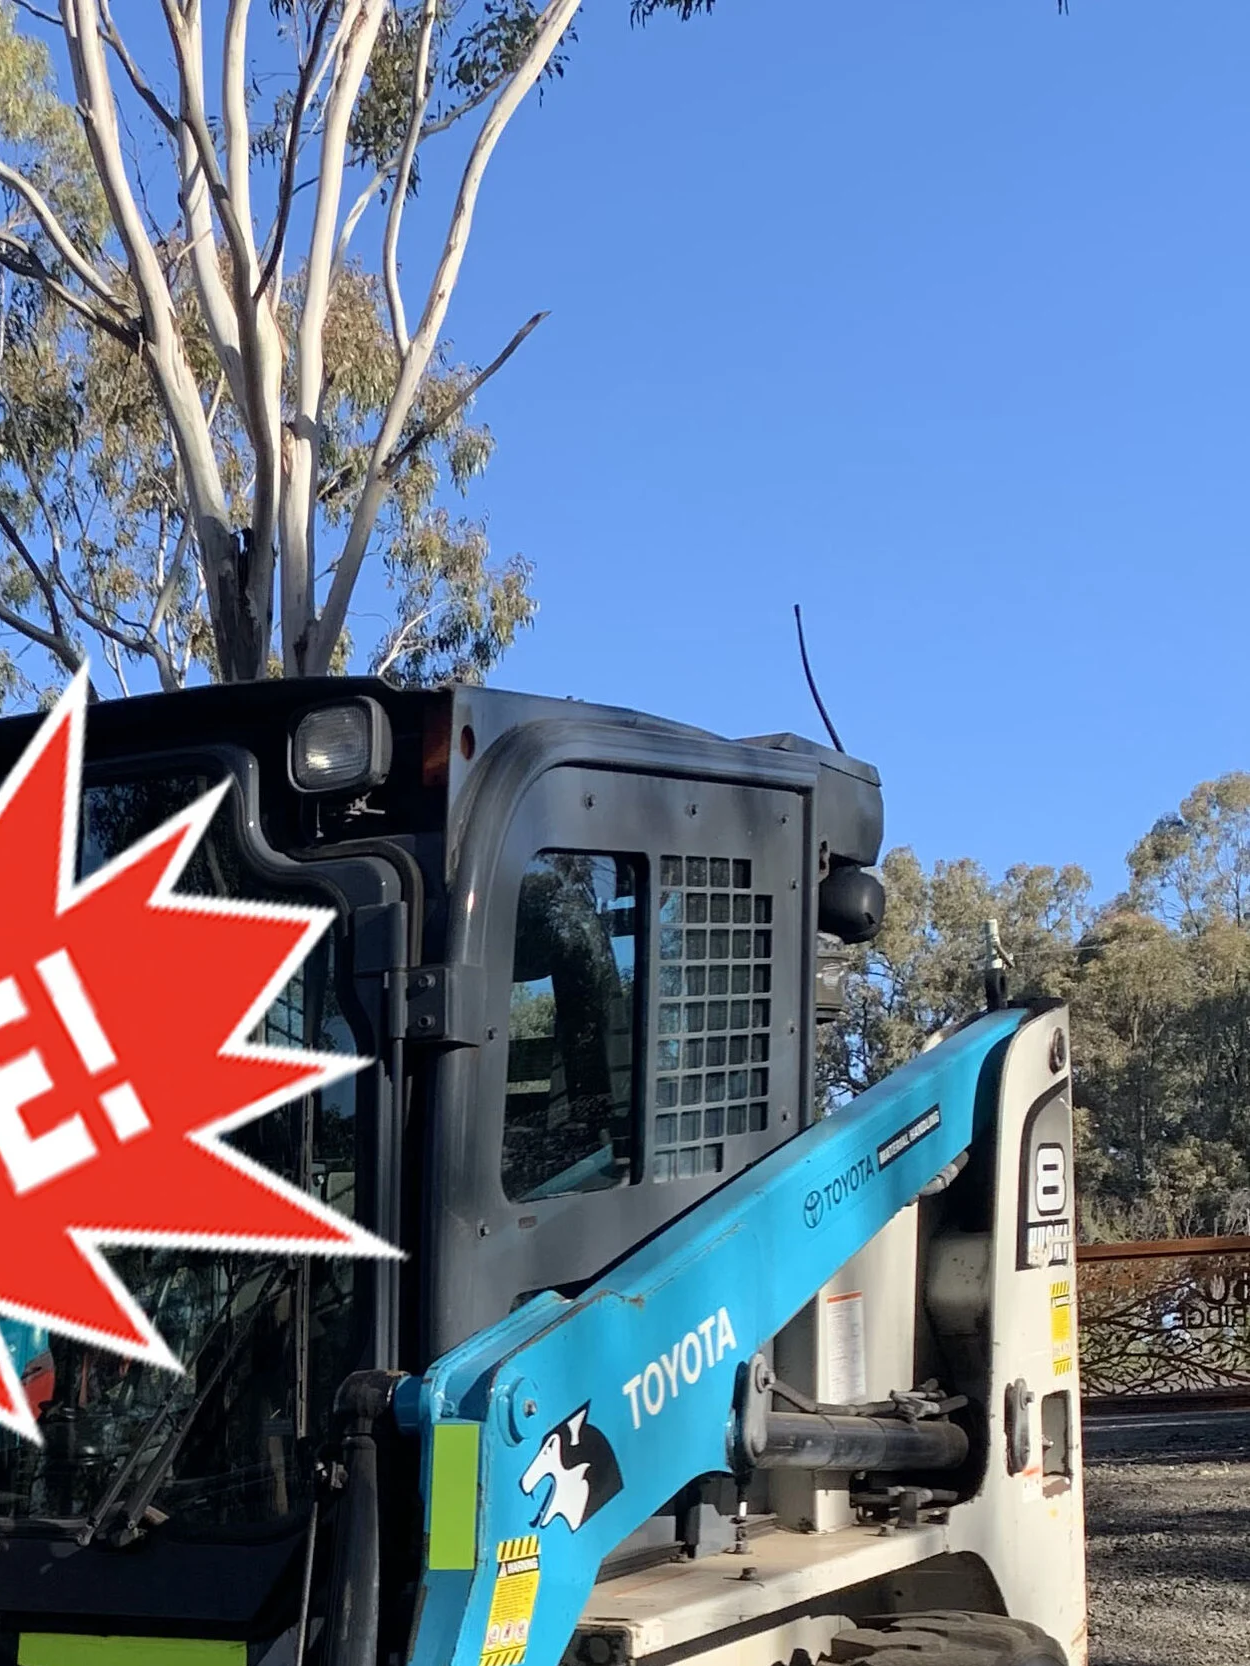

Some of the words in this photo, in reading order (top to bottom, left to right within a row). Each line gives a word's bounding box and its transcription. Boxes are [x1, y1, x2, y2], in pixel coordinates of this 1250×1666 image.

[823, 1154, 875, 1210] TOYOTA
[878, 1132, 910, 1165] MATERIAL
[1035, 1142, 1066, 1215] 8
[622, 1307, 736, 1430] TOYOTA
